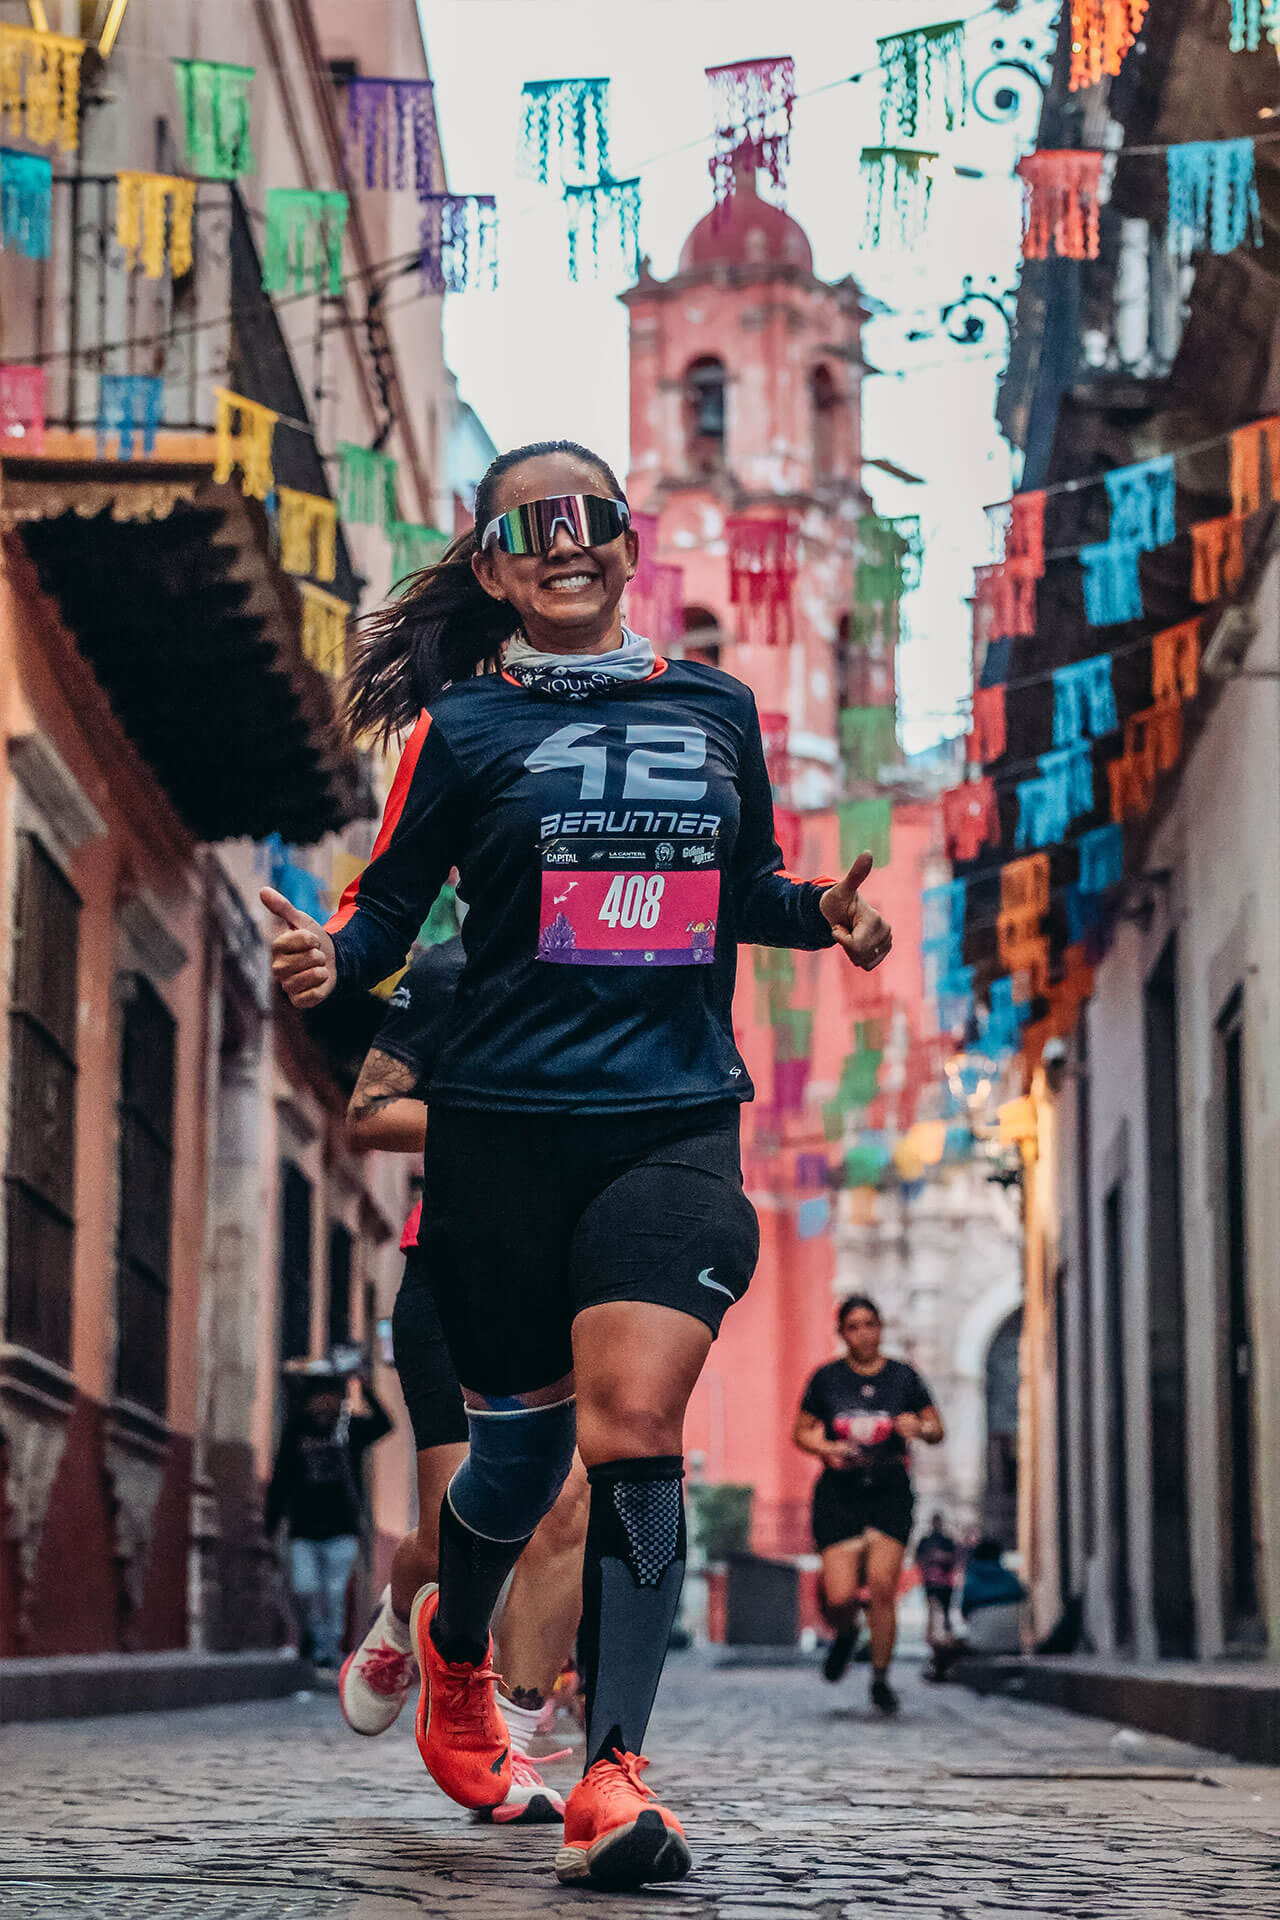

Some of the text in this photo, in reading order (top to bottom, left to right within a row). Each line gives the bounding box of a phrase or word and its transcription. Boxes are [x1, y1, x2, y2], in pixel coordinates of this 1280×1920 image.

[523, 722, 708, 801] 42
[540, 810, 721, 840] BERUNNER
[546, 853, 578, 863] CAPITAL
[598, 874, 665, 929] 408
